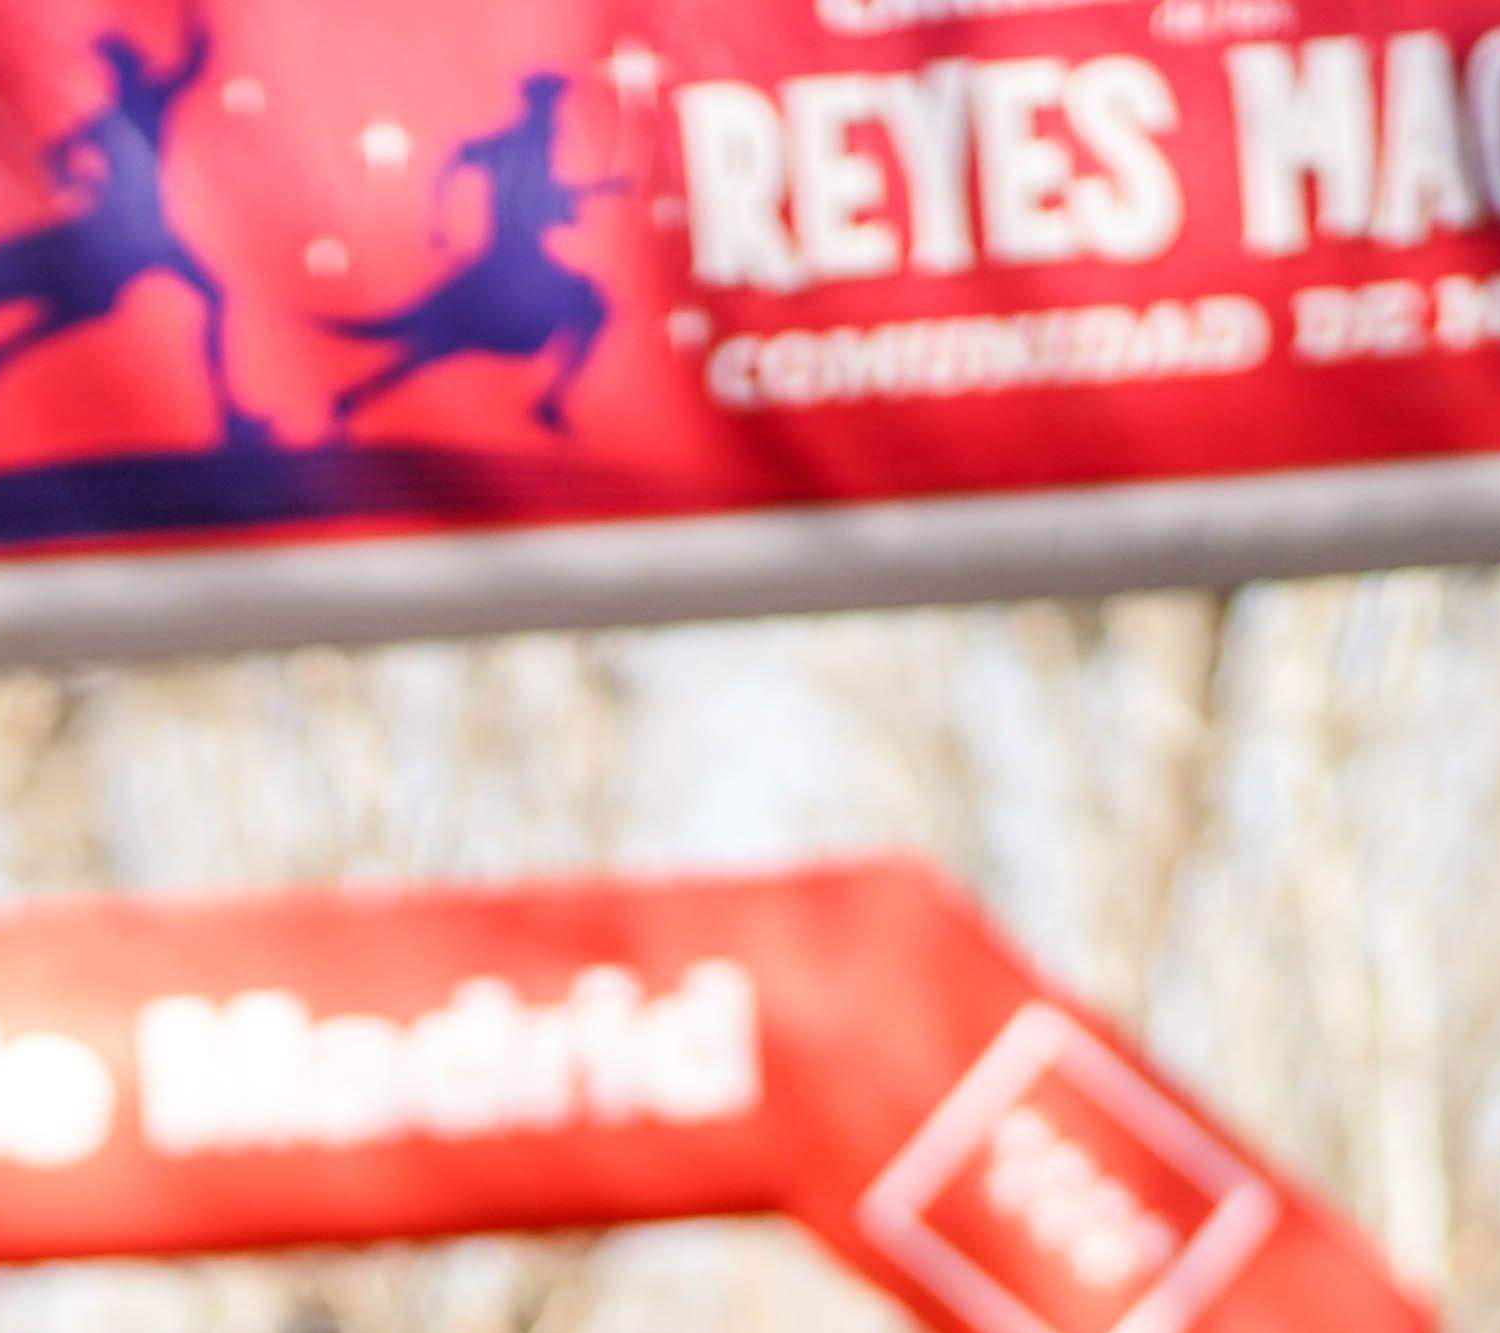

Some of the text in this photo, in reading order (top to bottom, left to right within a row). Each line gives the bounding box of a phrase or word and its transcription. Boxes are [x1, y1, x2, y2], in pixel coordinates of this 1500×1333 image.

[675, 54, 1184, 293] REYES
[706, 294, 1271, 408] COMUNIDAD
[1293, 278, 1428, 363] DE
[134, 960, 758, 1154] Madrid
